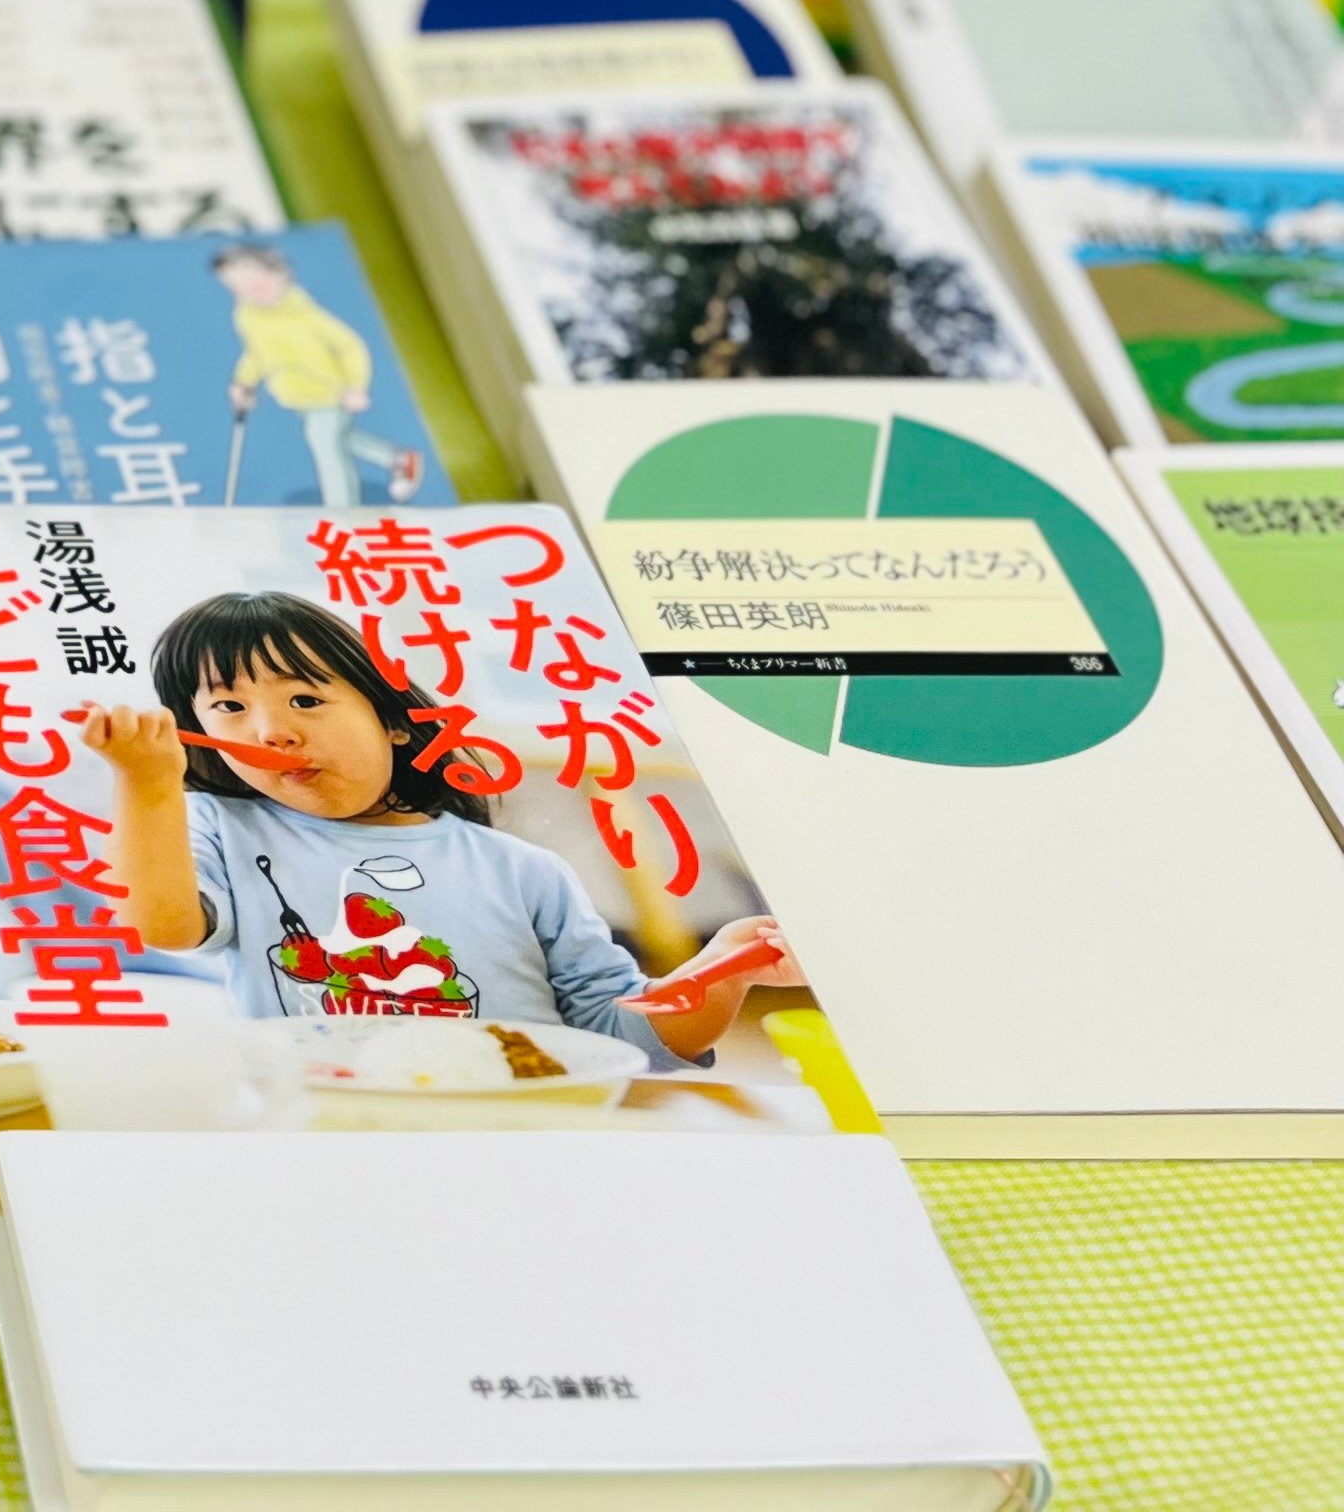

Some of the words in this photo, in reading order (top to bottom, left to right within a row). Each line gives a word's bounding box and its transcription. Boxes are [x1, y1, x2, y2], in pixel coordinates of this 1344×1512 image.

[28, 521, 112, 614] 湯浅
[632, 546, 1048, 584] 紛争解決ってなんだろう
[654, 600, 834, 632] 篠田英朗
[56, 626, 136, 676] 誠
[308, 520, 524, 796] 続ける
[726, 654, 850, 674] ちくまプリマー新書
[1068, 654, 1106, 674] 366
[446, 524, 700, 898] つながり
[470, 1375, 639, 1400] 中央公論新社
